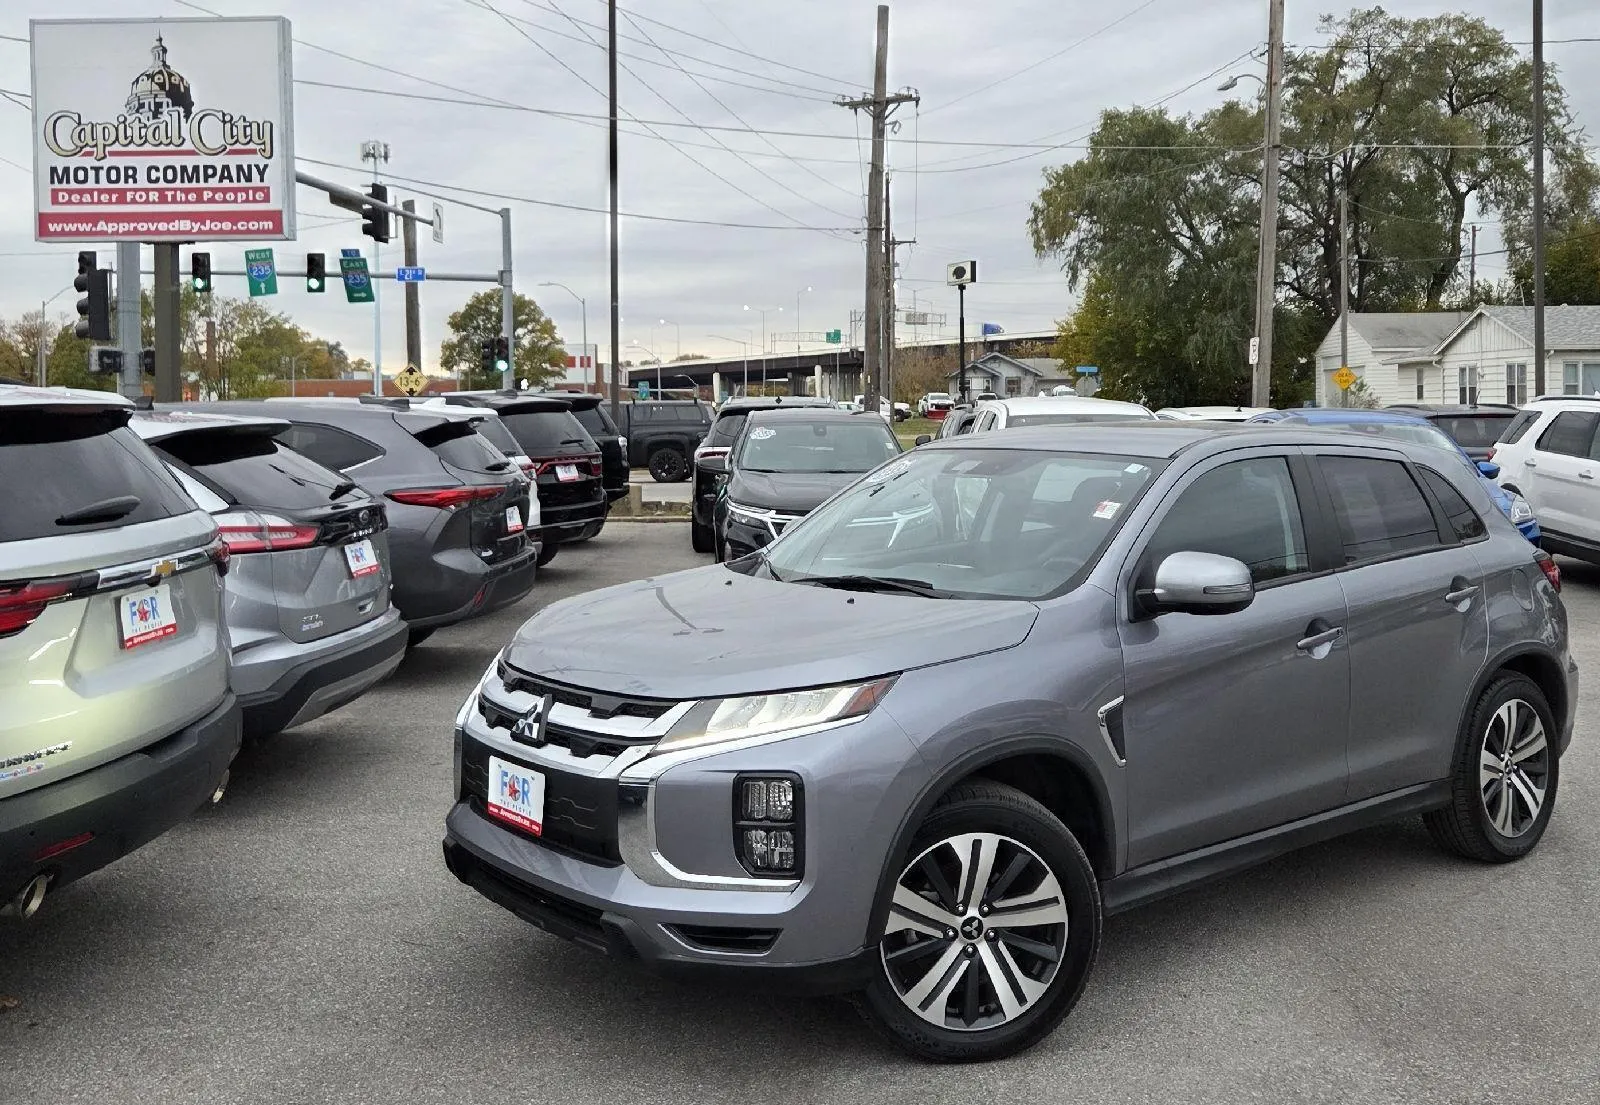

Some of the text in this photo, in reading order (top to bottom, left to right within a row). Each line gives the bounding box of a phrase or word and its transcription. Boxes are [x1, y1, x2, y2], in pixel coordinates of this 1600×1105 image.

[44, 109, 273, 160] Capital City
[50, 164, 269, 185] MOTOR COMPANY
[58, 189, 265, 203] Dealer FOR The People
[48, 219, 273, 234] www.ApprovedByJoe.com
[252, 265, 271, 276] 235
[348, 274, 367, 284] 235
[501, 770, 531, 807] FOR
